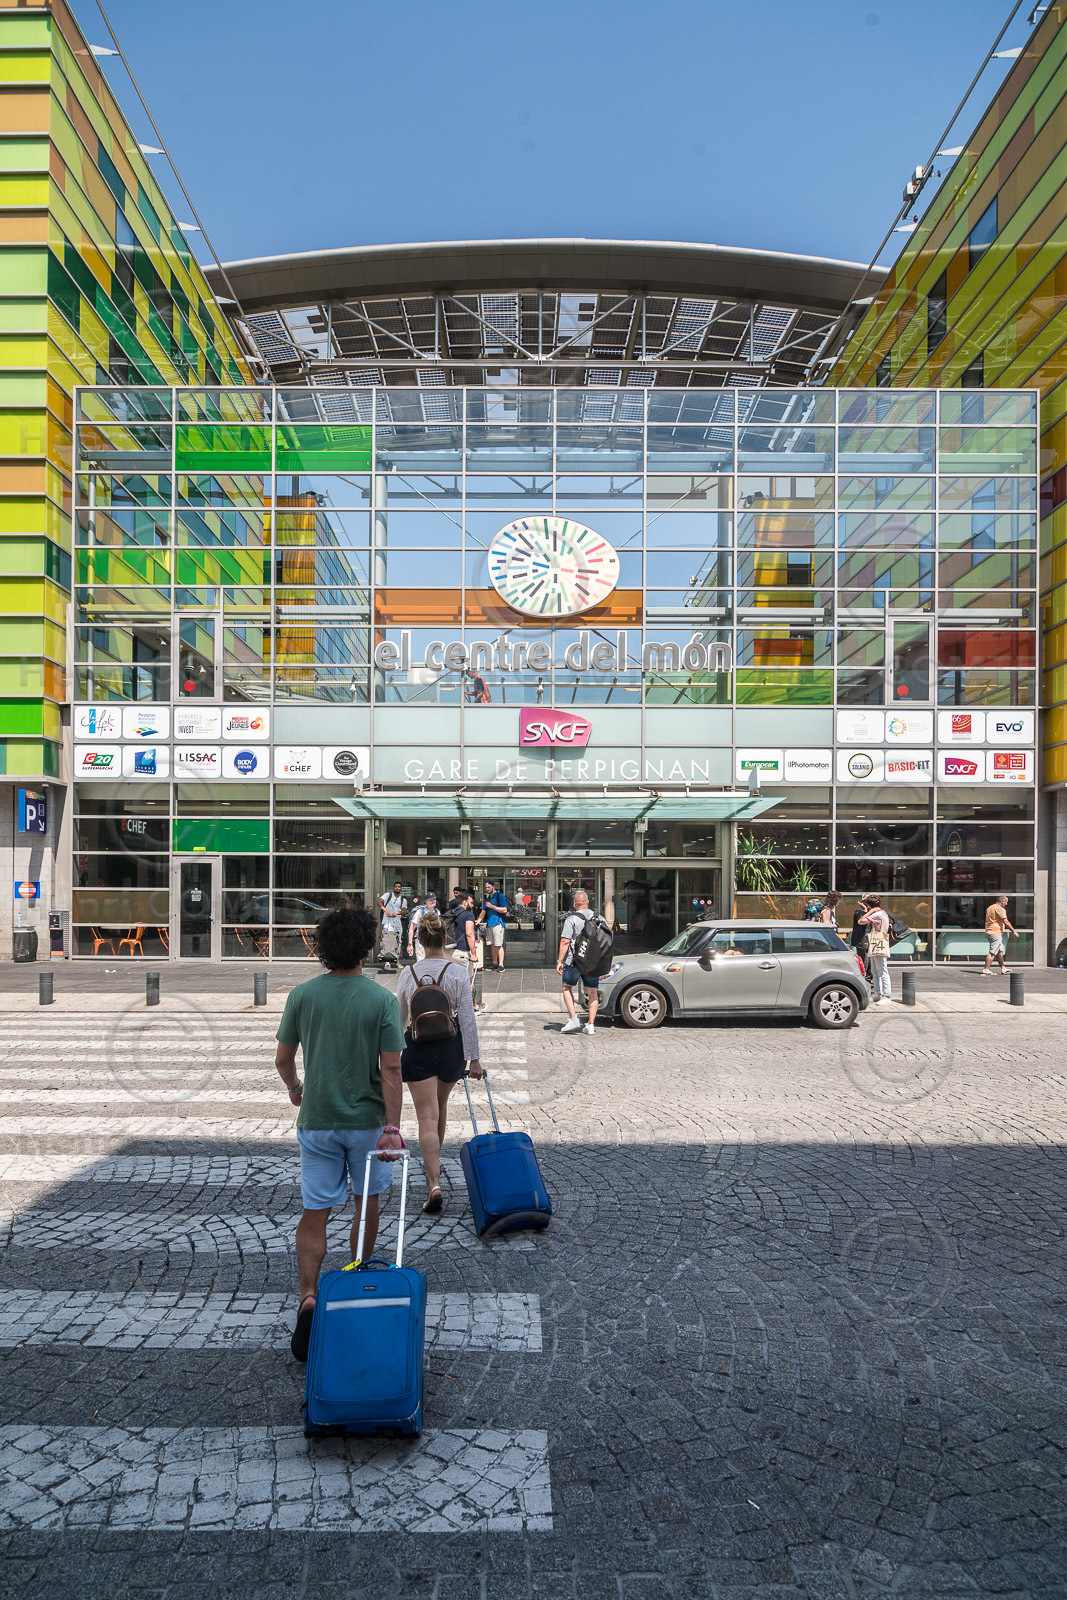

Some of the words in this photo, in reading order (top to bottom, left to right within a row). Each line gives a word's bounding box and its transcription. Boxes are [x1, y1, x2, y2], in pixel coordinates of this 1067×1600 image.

[374, 630, 411, 672] el
[425, 634, 551, 672] centre
[565, 630, 628, 672] del
[642, 631, 733, 673] món
[178, 725, 194, 734] INVEST
[522, 721, 590, 742] SNCF
[995, 722, 1023, 732] EVO
[85, 754, 111, 764] G20
[179, 753, 217, 762] LISSAC
[404, 759, 480, 780] GARE
[495, 760, 528, 780] DE
[544, 760, 711, 780] PERPIGNAN
[888, 760, 931, 772] BASIC-FIT
[946, 763, 975, 775] SNCF
[26, 804, 37, 830] P
[520, 868, 542, 876] SNCF
[870, 940, 886, 953] 74
